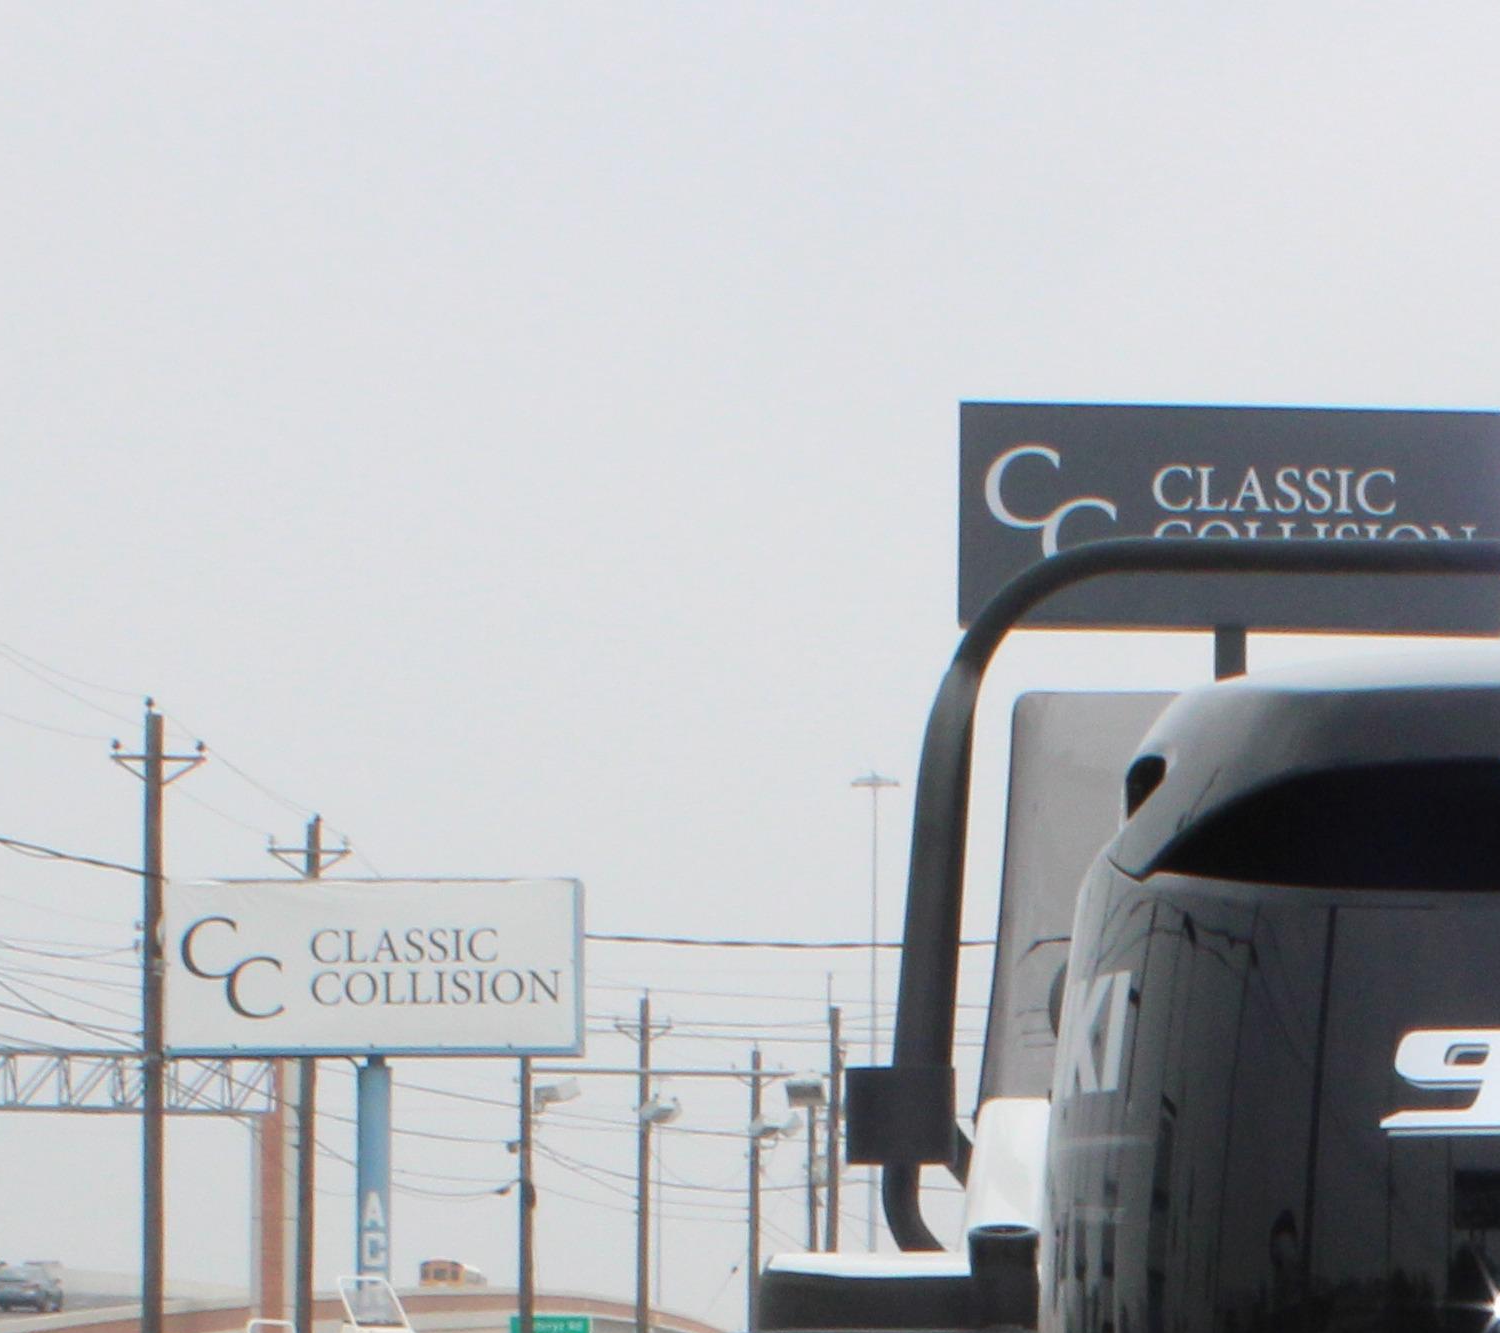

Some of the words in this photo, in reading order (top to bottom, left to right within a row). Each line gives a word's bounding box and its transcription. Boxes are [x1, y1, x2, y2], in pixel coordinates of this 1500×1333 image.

[1151, 465, 1397, 514] CLASSIC
[310, 928, 499, 965] CLASSIC
[310, 969, 563, 1006] COLLISION
